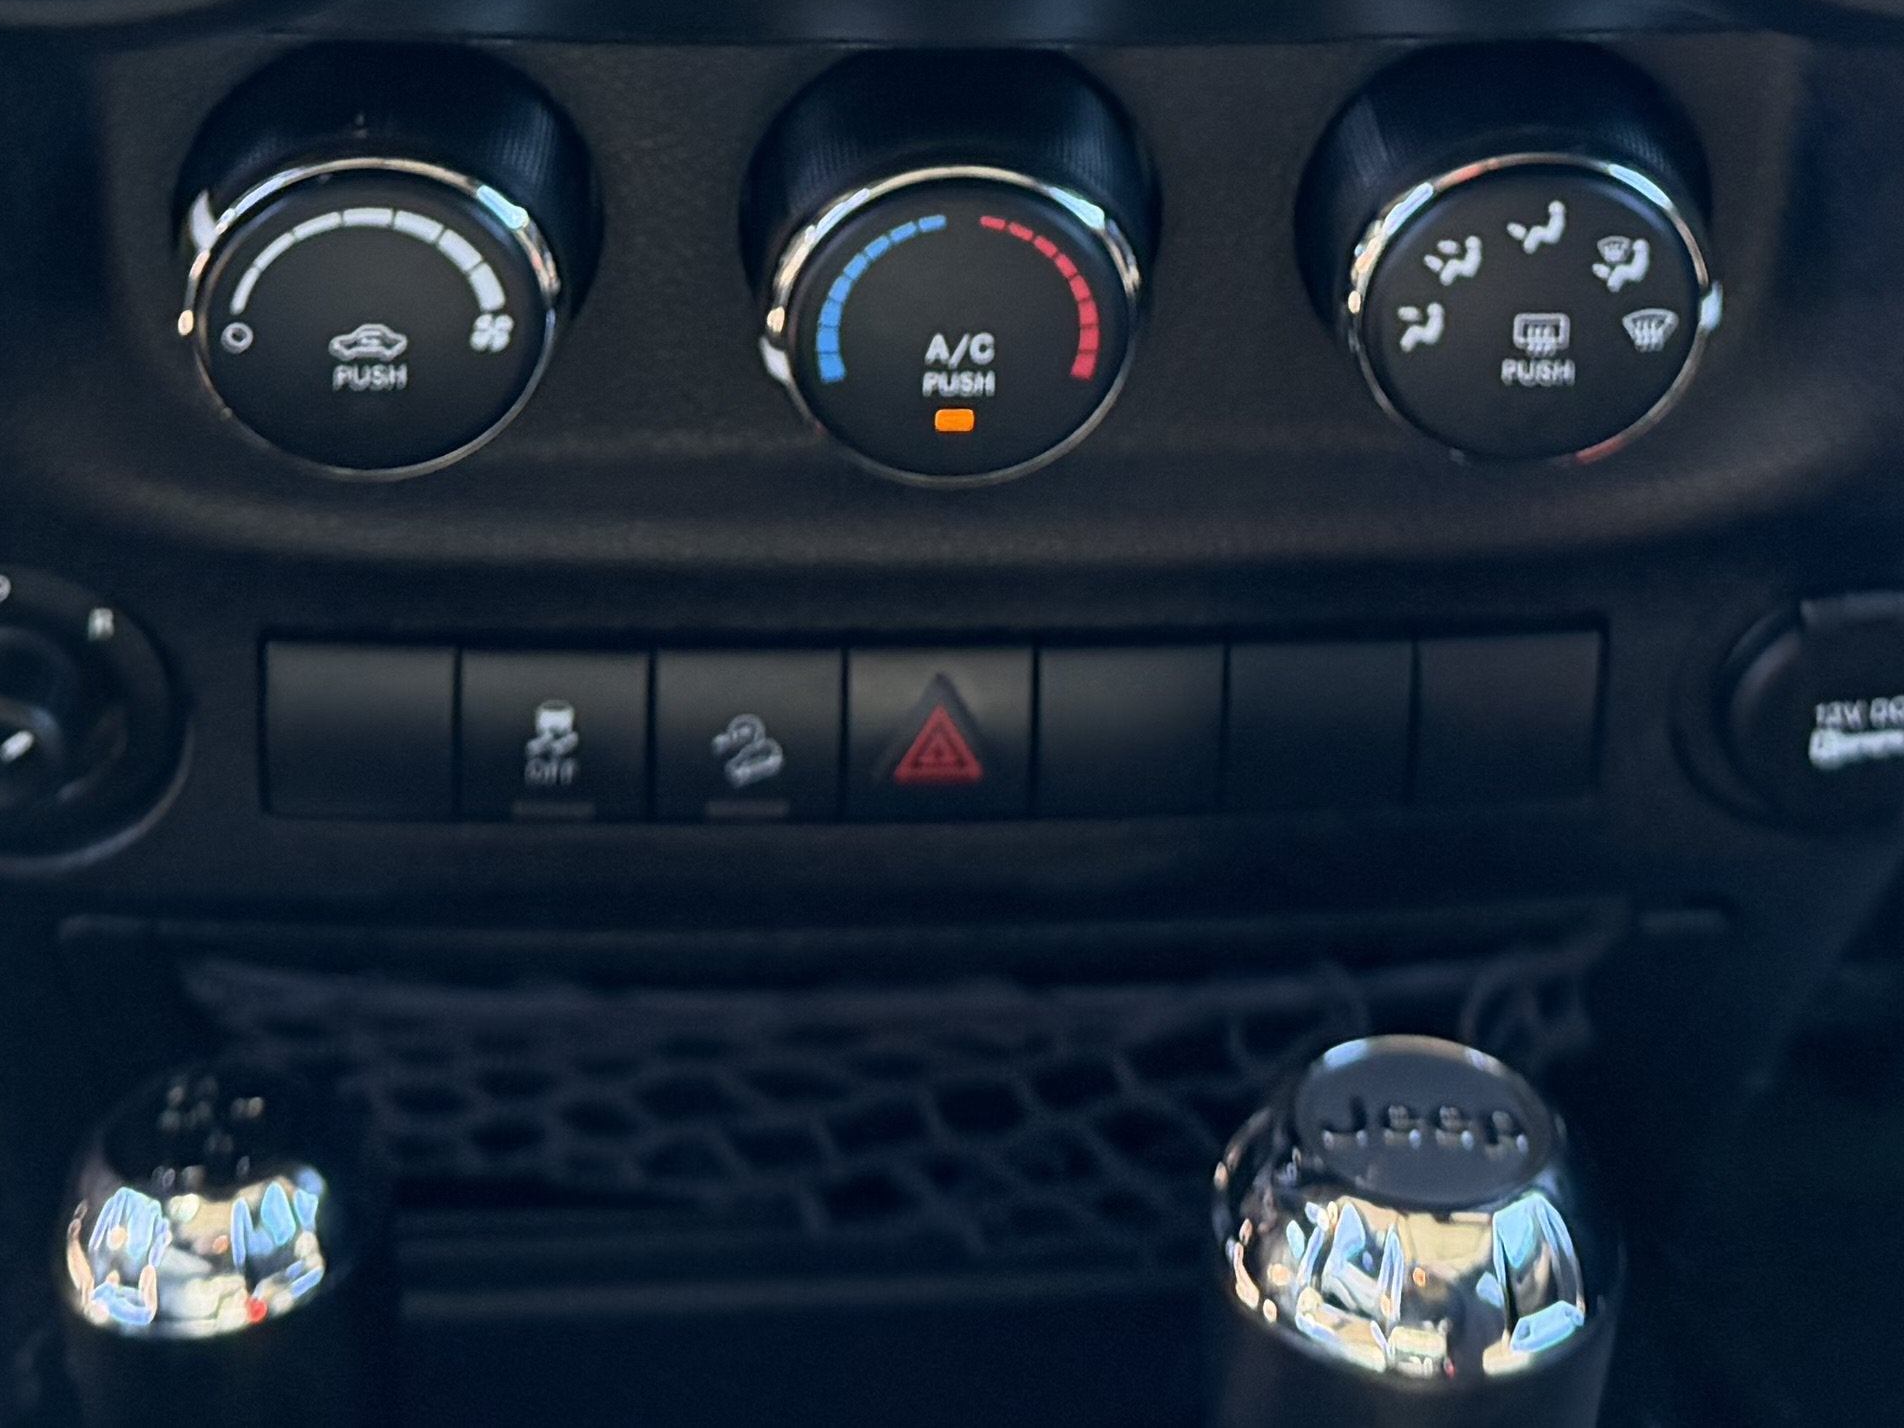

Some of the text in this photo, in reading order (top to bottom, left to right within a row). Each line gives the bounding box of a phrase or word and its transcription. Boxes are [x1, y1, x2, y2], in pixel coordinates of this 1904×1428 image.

[925, 331, 995, 364] A/C
[333, 362, 408, 390] PUSH
[922, 370, 996, 396] PUSH
[1500, 358, 1576, 386] PUSH
